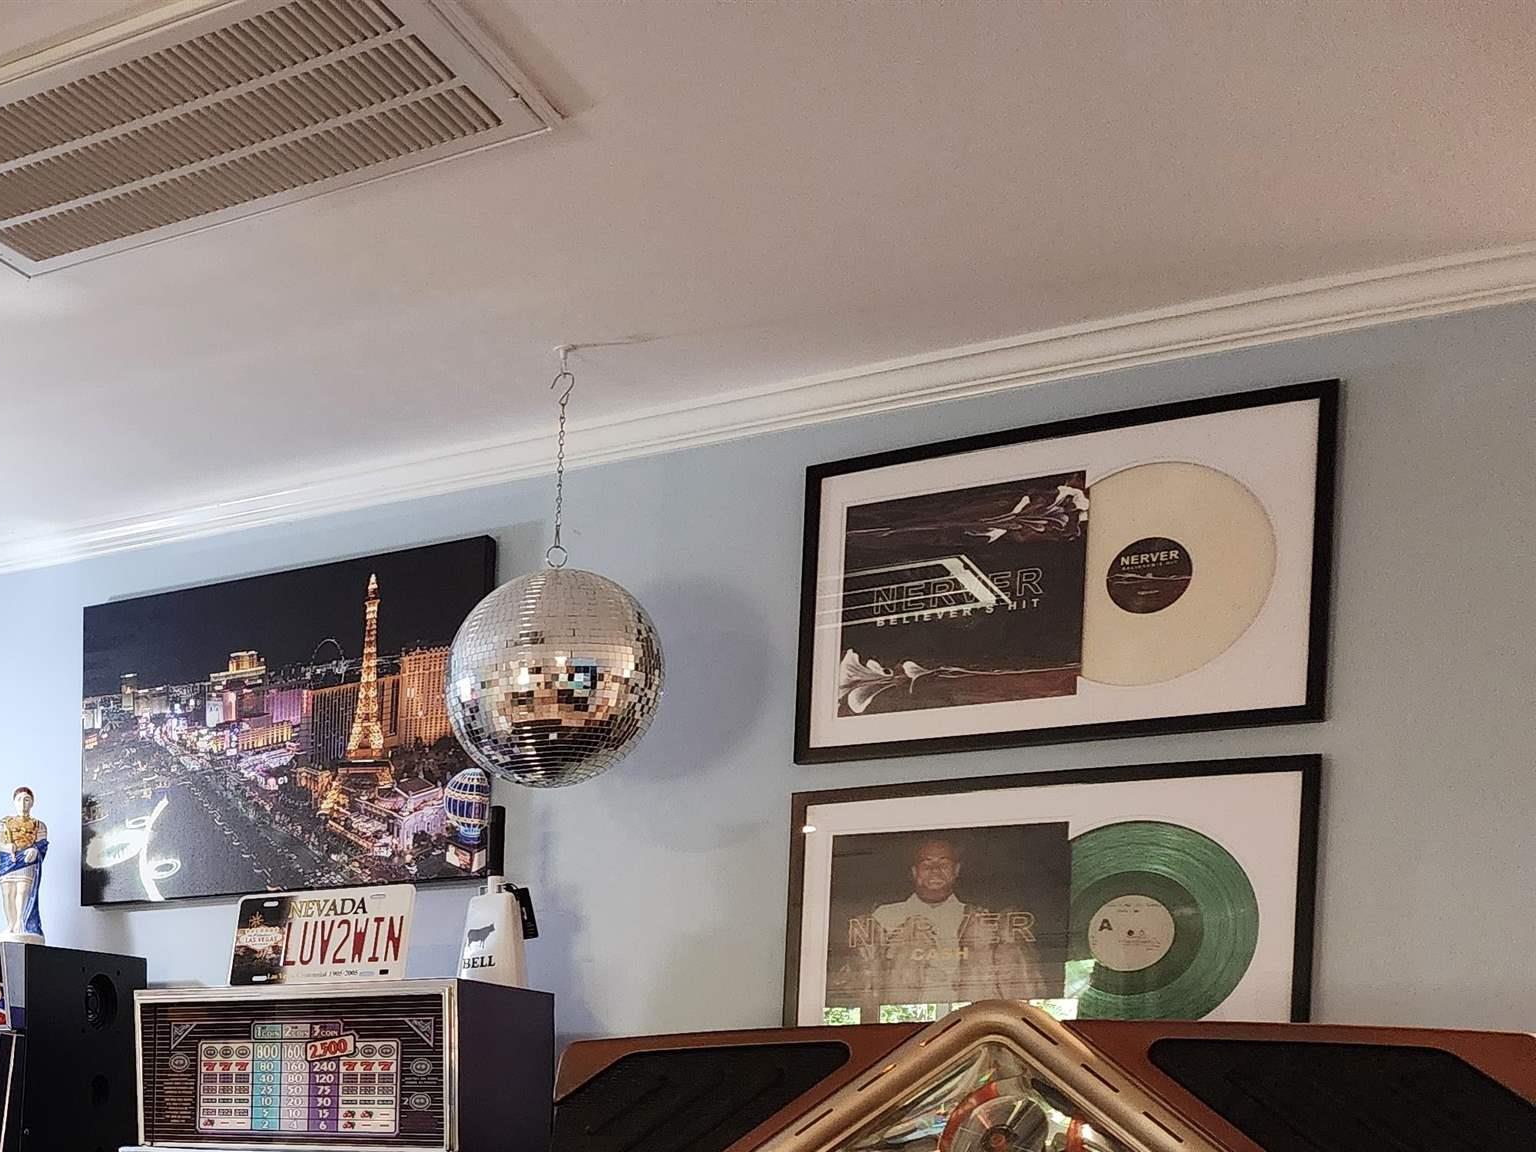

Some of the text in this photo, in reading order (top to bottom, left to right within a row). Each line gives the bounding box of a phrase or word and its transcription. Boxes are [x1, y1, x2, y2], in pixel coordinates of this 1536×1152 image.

[1120, 549, 1180, 566] NERVER
[1007, 598, 1041, 611] HIT
[288, 897, 368, 919] NEVADA
[1098, 918, 1113, 932] A
[283, 916, 404, 967] LUV2WIN
[463, 955, 496, 969] BELL
[256, 1044, 278, 1059] 800
[259, 1062, 274, 1071] 80
[286, 1061, 305, 1071] 160
[313, 1061, 336, 1072] 240
[259, 1074, 334, 1083] 40 80 120
[260, 1086, 331, 1095] 25 50 75
[261, 1097, 272, 1106] 10
[288, 1097, 301, 1106] 20
[317, 1098, 331, 1107] 30
[263, 1109, 329, 1118] 5 10 15
[262, 1121, 327, 1130] 2 4 6
